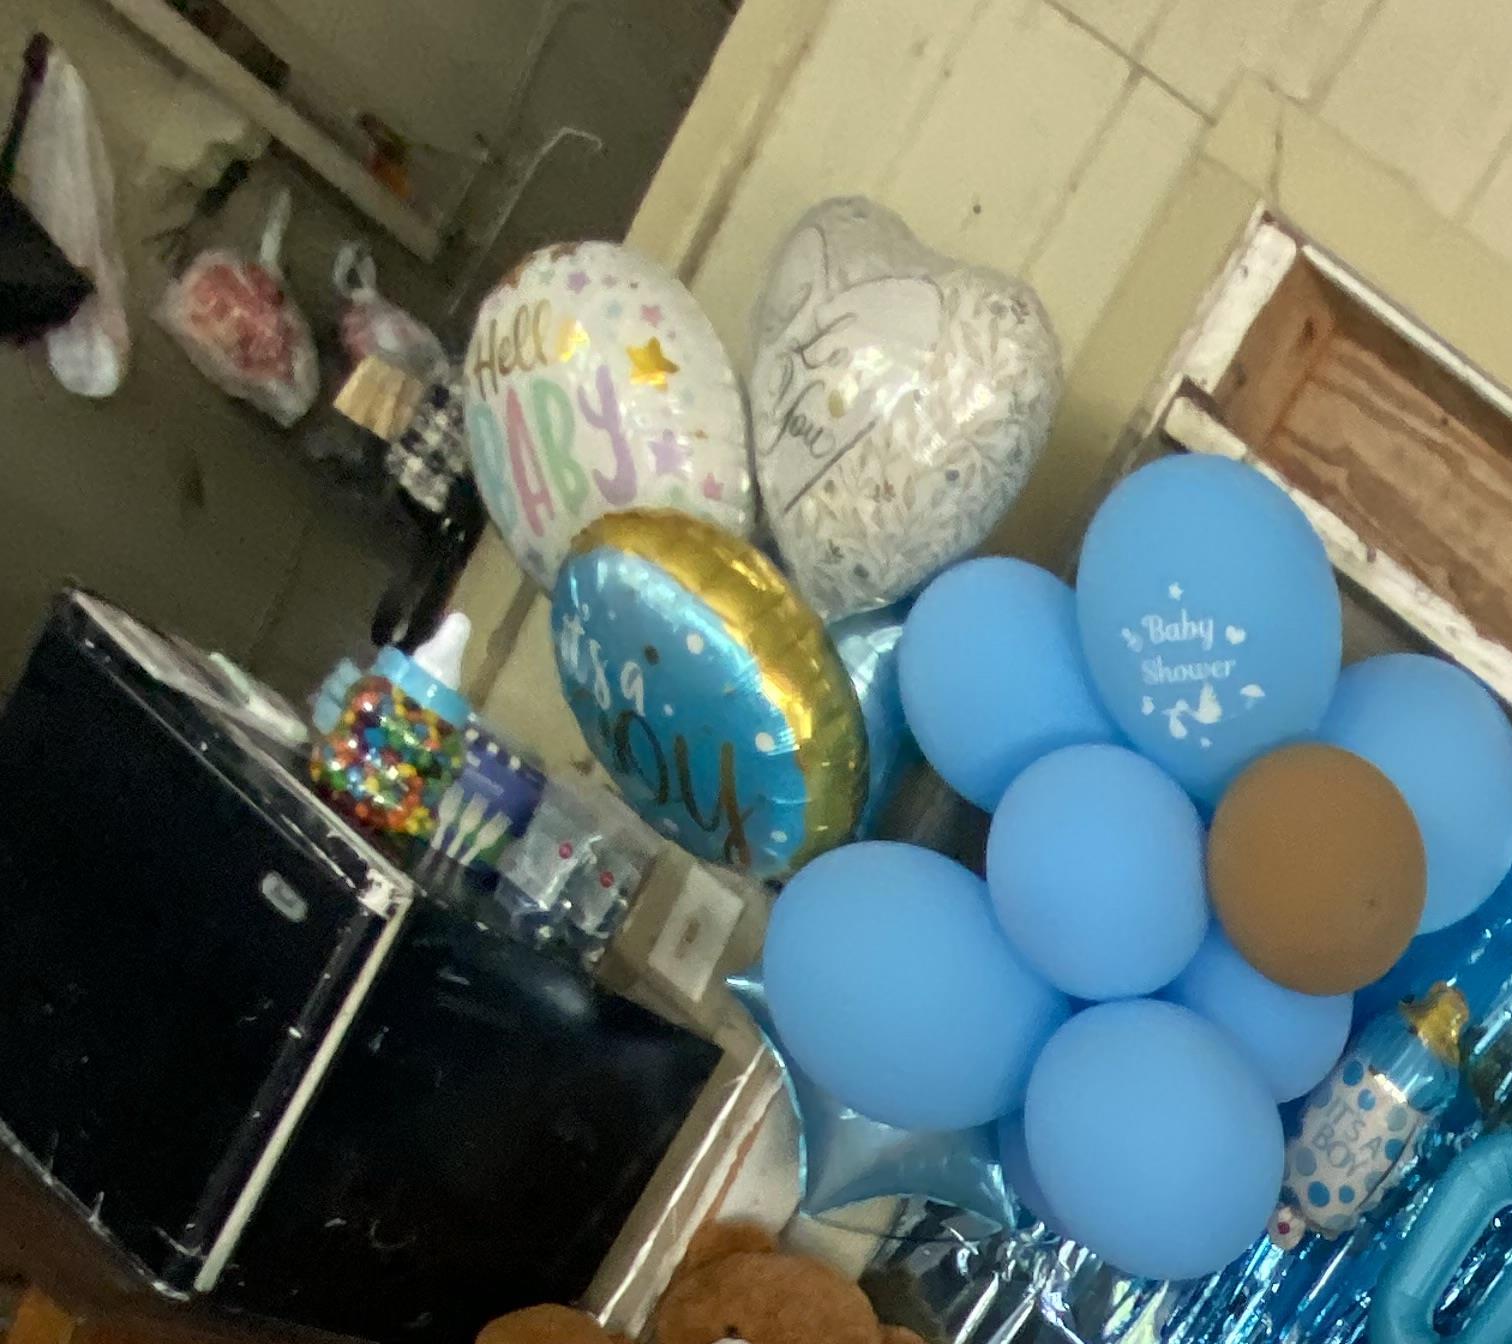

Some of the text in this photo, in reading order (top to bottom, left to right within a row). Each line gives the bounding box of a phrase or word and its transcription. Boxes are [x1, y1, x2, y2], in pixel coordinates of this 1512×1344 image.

[467, 363, 638, 545] BABY
[1141, 608, 1214, 651] Baby
[1141, 655, 1237, 685] Shower
